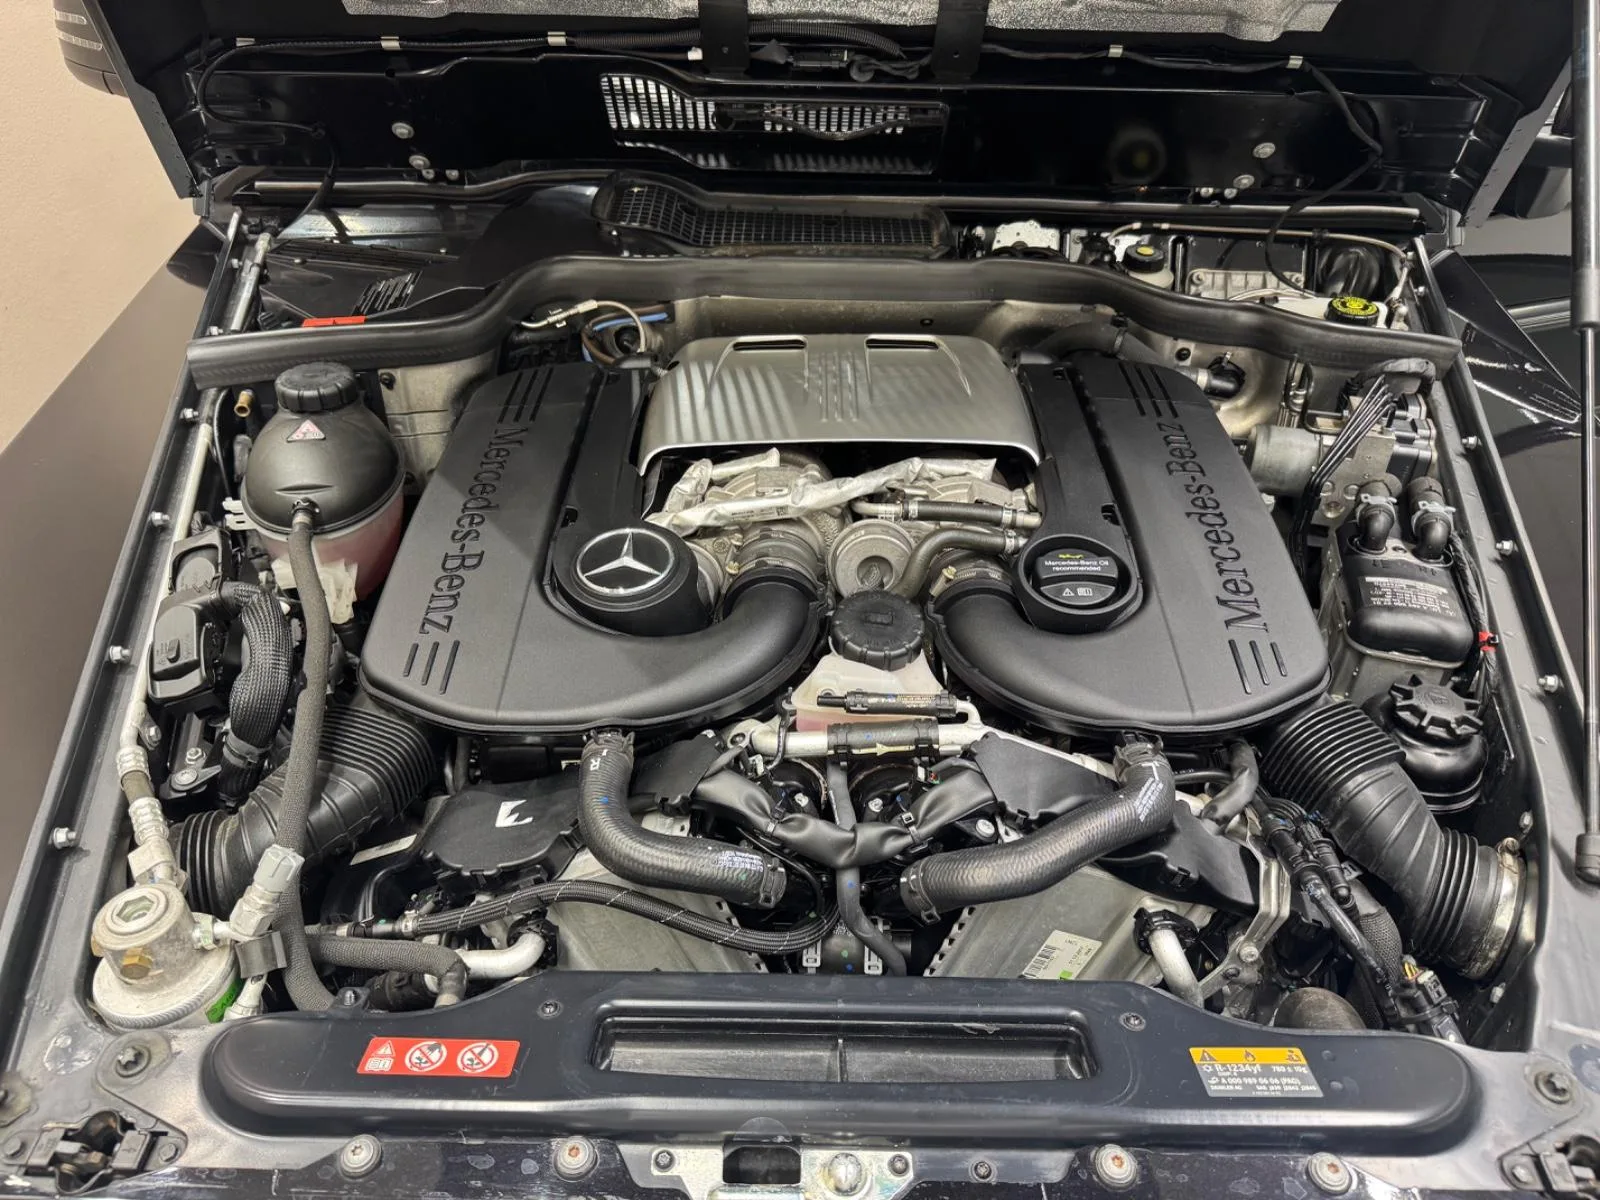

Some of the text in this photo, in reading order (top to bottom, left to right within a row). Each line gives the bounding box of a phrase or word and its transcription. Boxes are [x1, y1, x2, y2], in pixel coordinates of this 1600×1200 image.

[419, 427, 529, 634] Mercedes-Benz
[1157, 422, 1269, 633] Mercedes-Benz
[1214, 1063, 1262, 1074] R-1234yf
